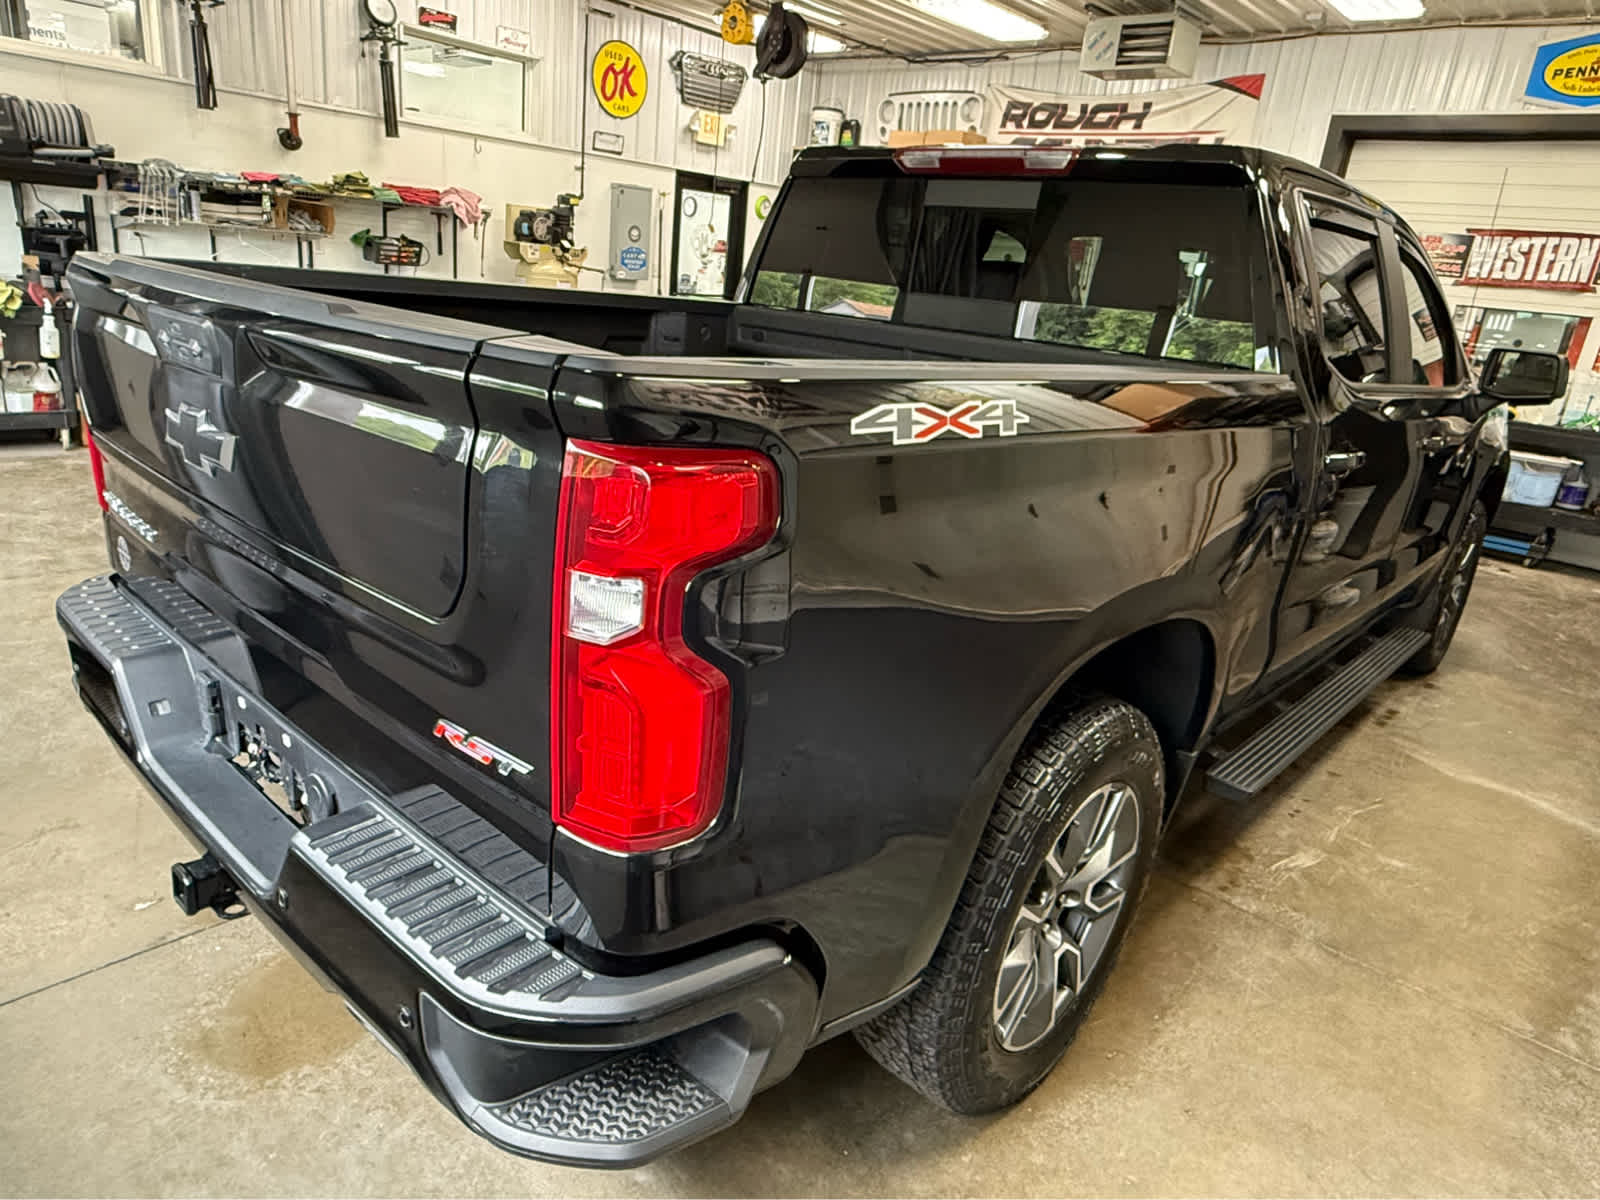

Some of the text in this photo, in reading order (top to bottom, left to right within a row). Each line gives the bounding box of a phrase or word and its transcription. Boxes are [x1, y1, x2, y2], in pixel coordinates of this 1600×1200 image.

[604, 49, 624, 61] USED
[601, 56, 638, 102] OK
[612, 102, 630, 113] CARS
[1000, 101, 1152, 130] ROUGH
[1467, 235, 1600, 284] WESTERN
[433, 718, 535, 777] RST
